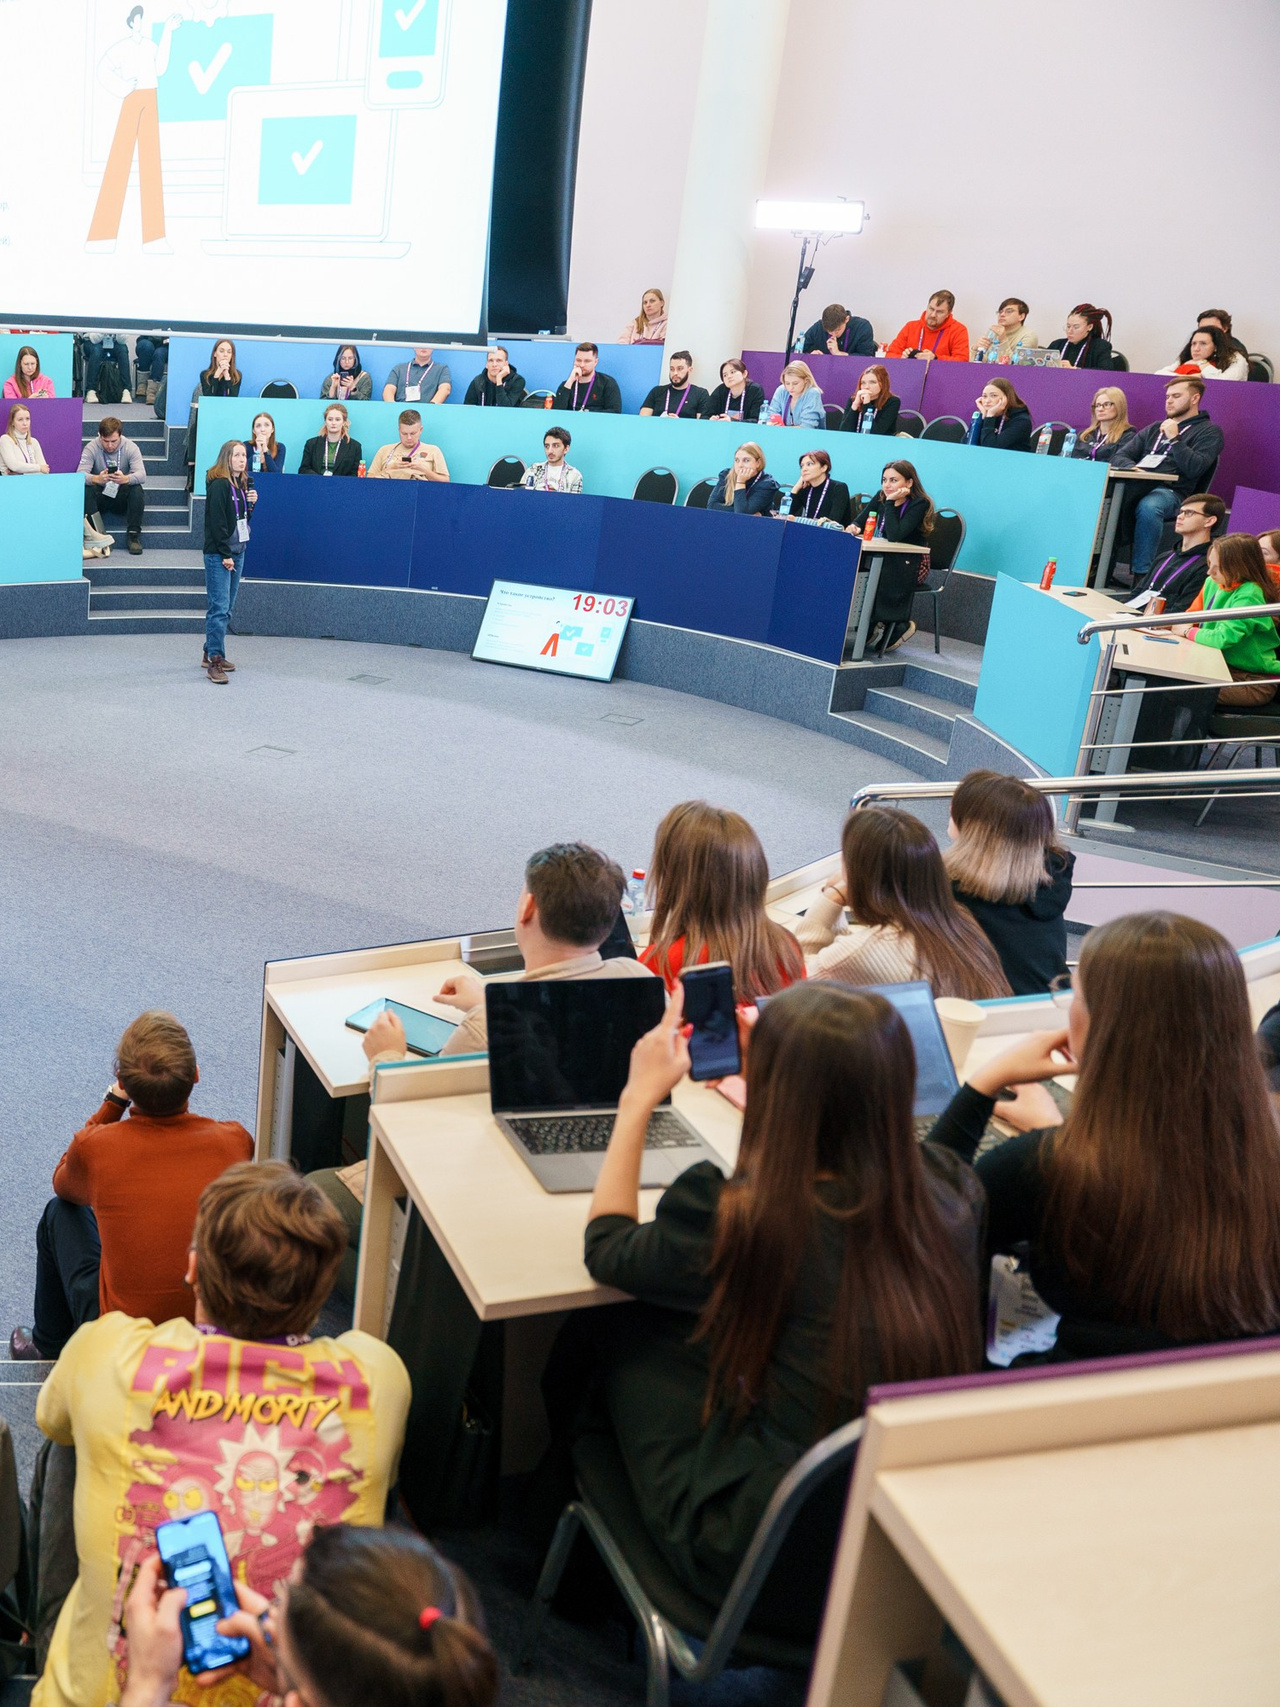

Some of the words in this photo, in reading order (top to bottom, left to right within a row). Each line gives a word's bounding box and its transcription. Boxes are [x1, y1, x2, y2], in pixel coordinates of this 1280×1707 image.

[572, 594, 629, 617] 19:03
[151, 1388, 225, 1423] AND
[223, 1390, 341, 1432] MORTY
